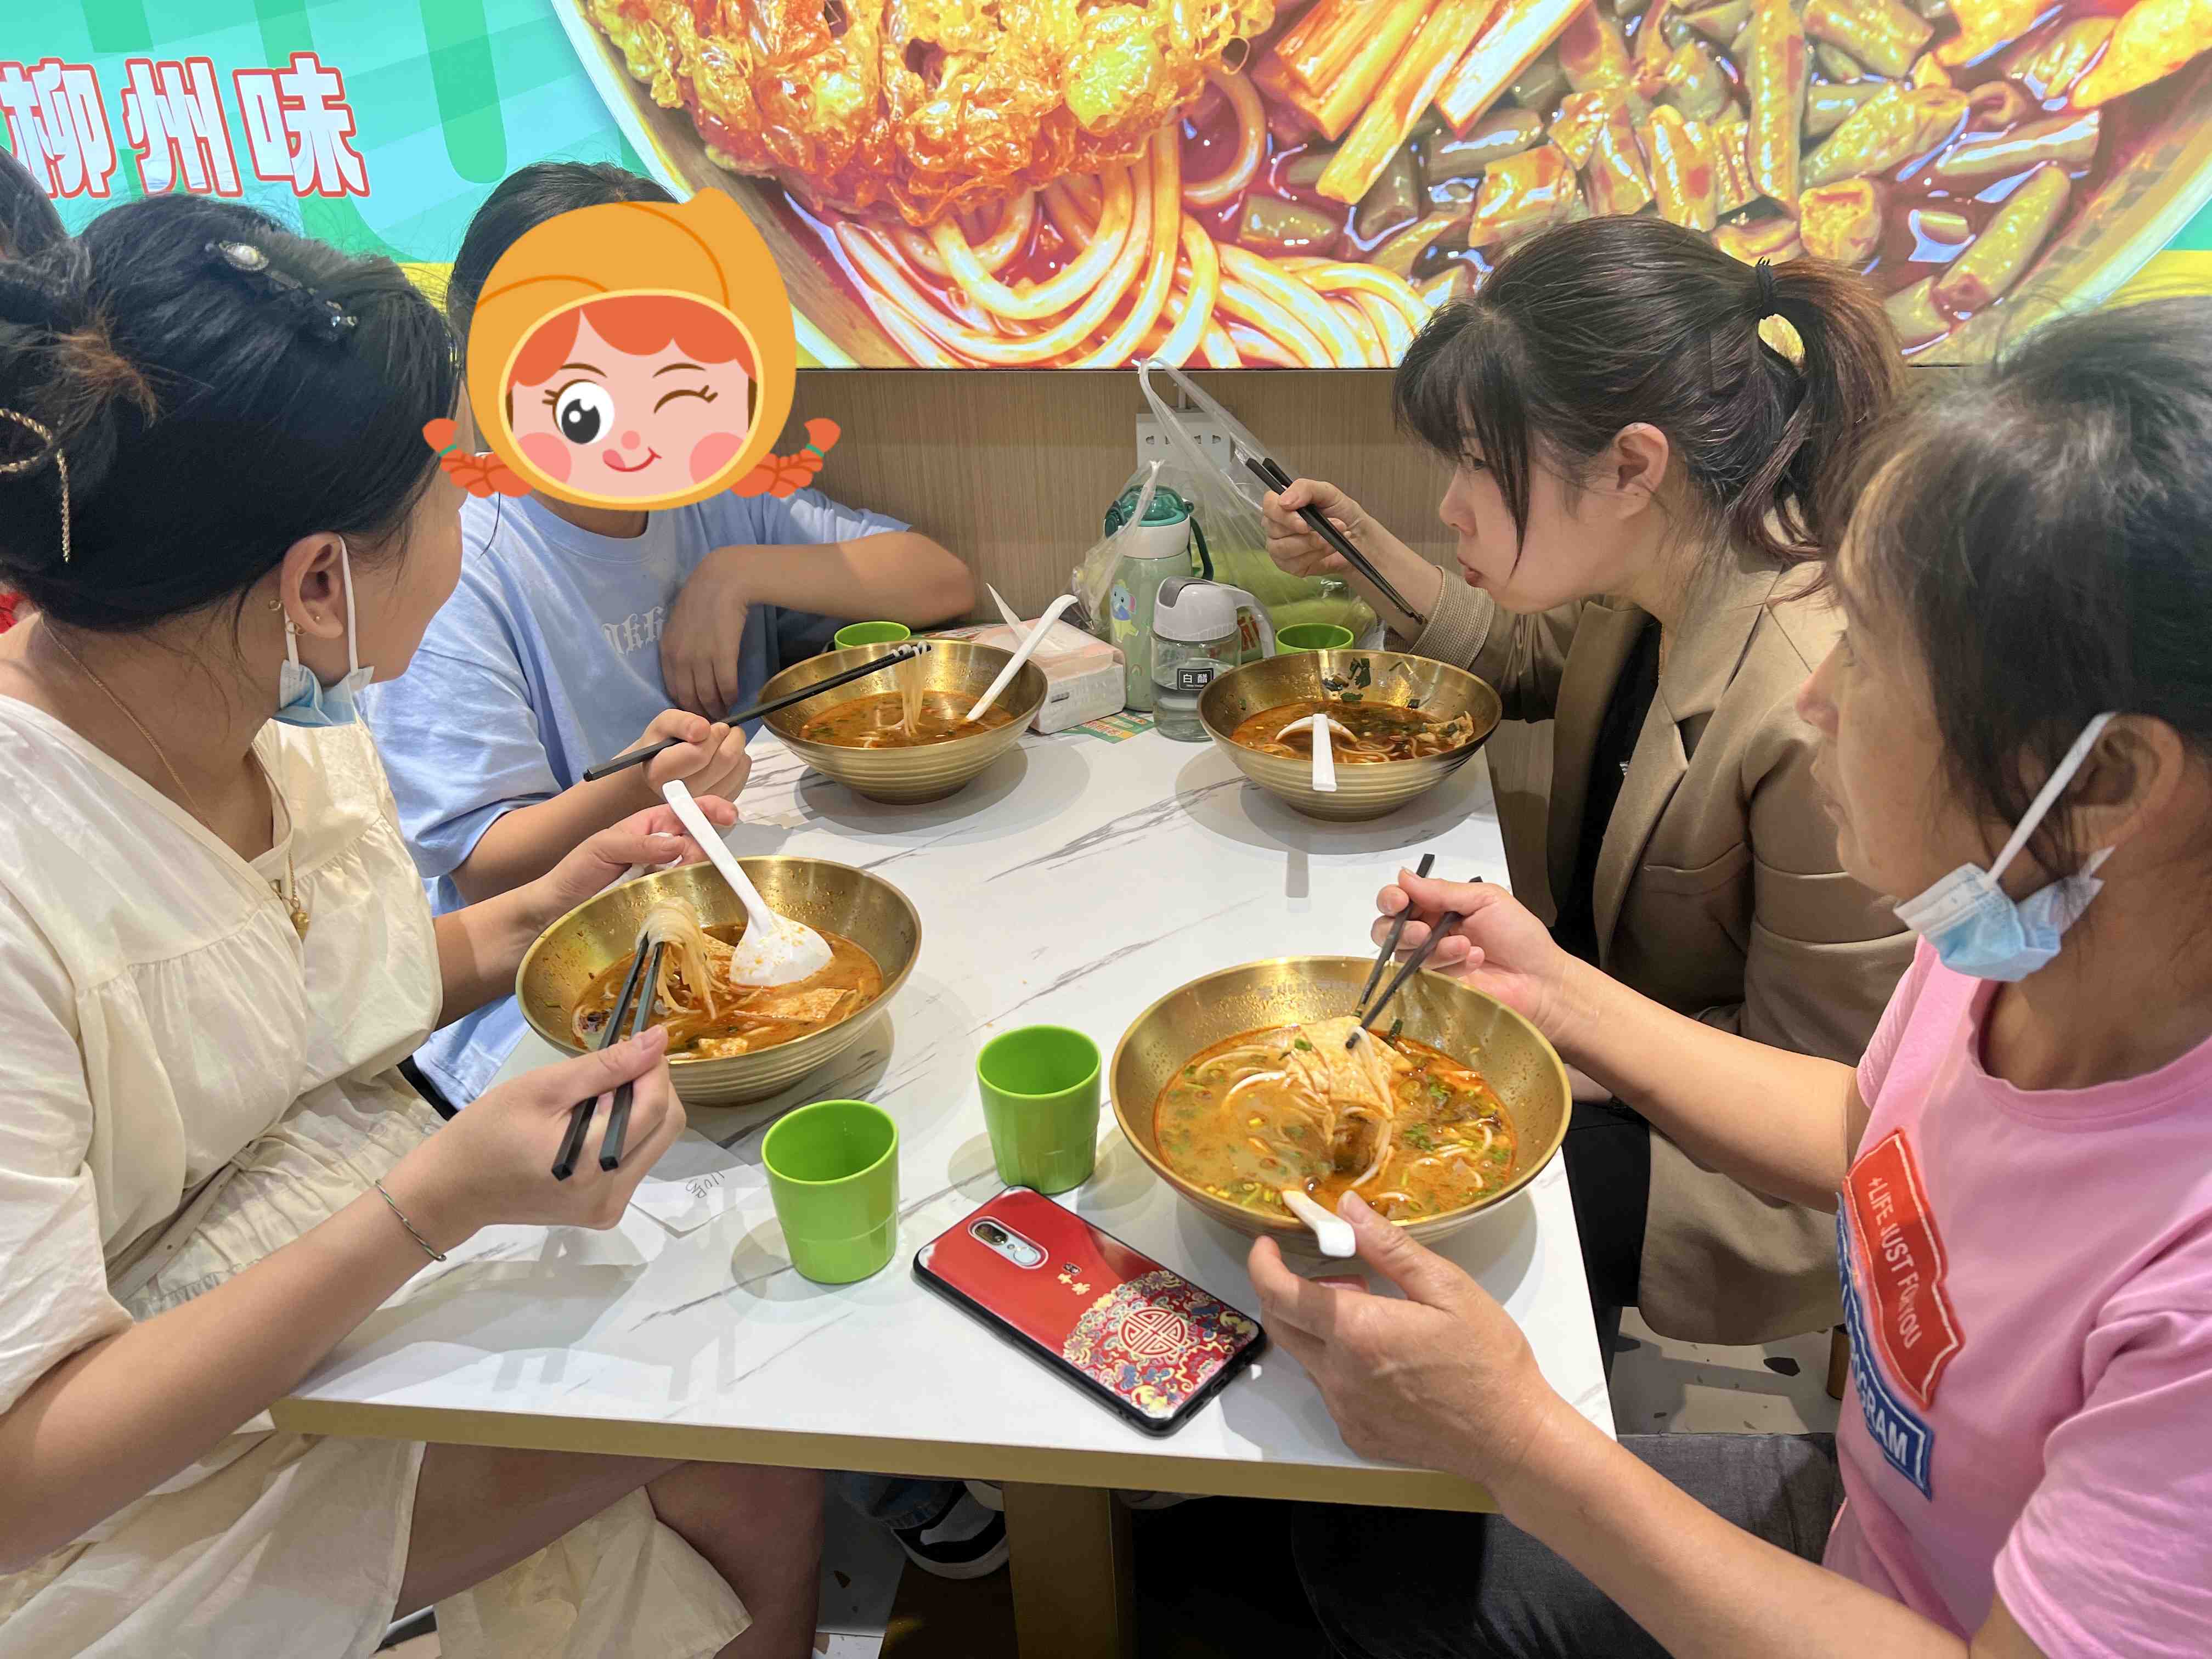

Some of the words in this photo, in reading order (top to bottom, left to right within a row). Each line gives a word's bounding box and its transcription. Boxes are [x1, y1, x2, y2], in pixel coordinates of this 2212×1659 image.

[0, 52, 370, 199] 柳州味
[1183, 673, 1208, 684] 白醋
[1880, 1223, 1915, 1273] JUST
